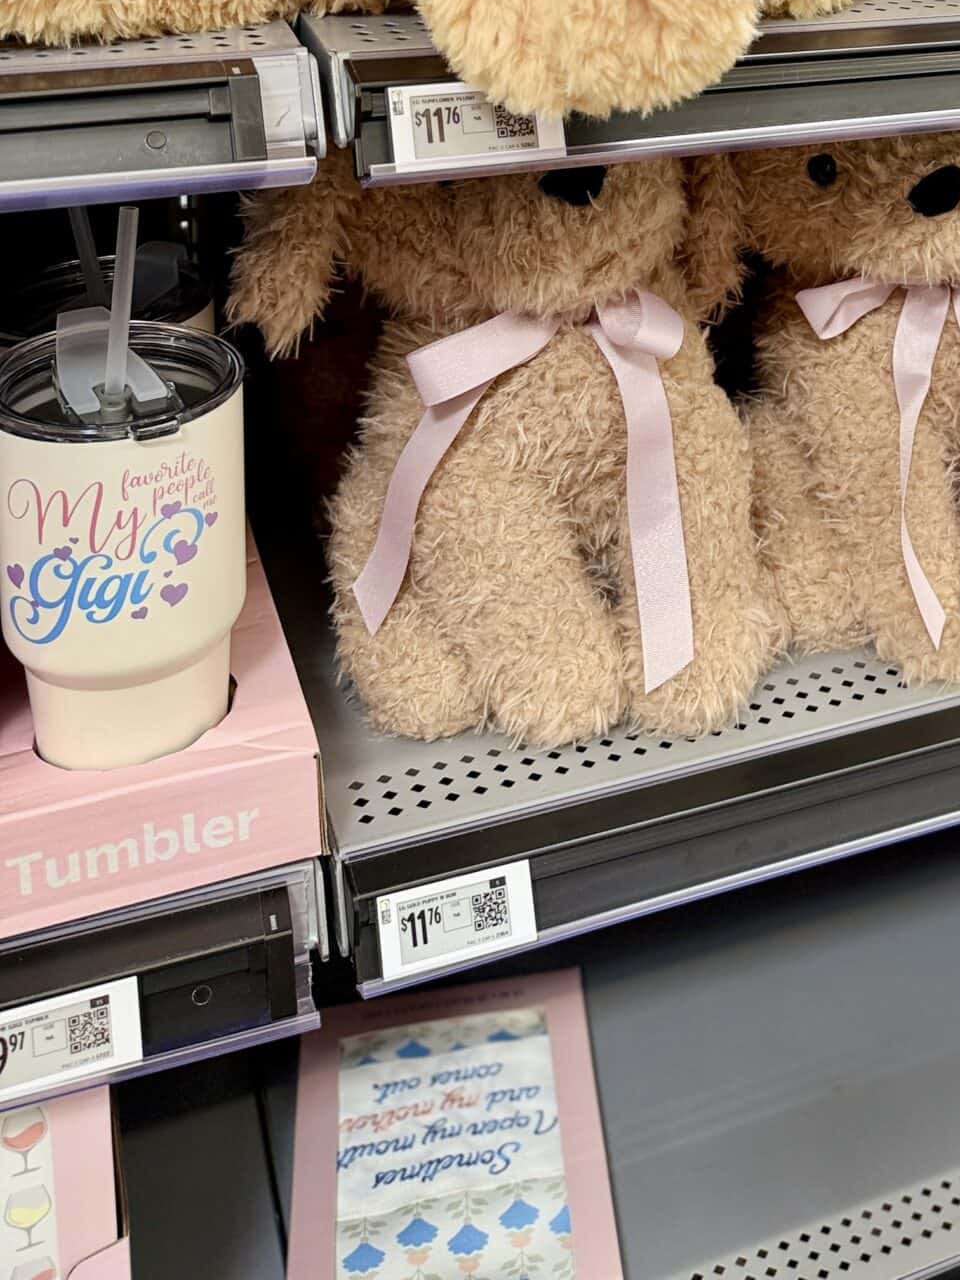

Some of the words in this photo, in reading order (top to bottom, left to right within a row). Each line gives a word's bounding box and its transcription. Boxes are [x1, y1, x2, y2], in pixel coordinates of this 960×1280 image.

[121, 451, 194, 501] favorite
[153, 458, 210, 516] people
[8, 478, 147, 560] My
[10, 553, 154, 645] Gigi
[5, 807, 259, 896] Tumbler
[430, 1062, 503, 1082] comes
[440, 1086, 480, 1110] my
[486, 1085, 541, 1110] and
[422, 1117, 463, 1141] my
[467, 1110, 530, 1136] open
[371, 1141, 521, 1189] Sometimes
